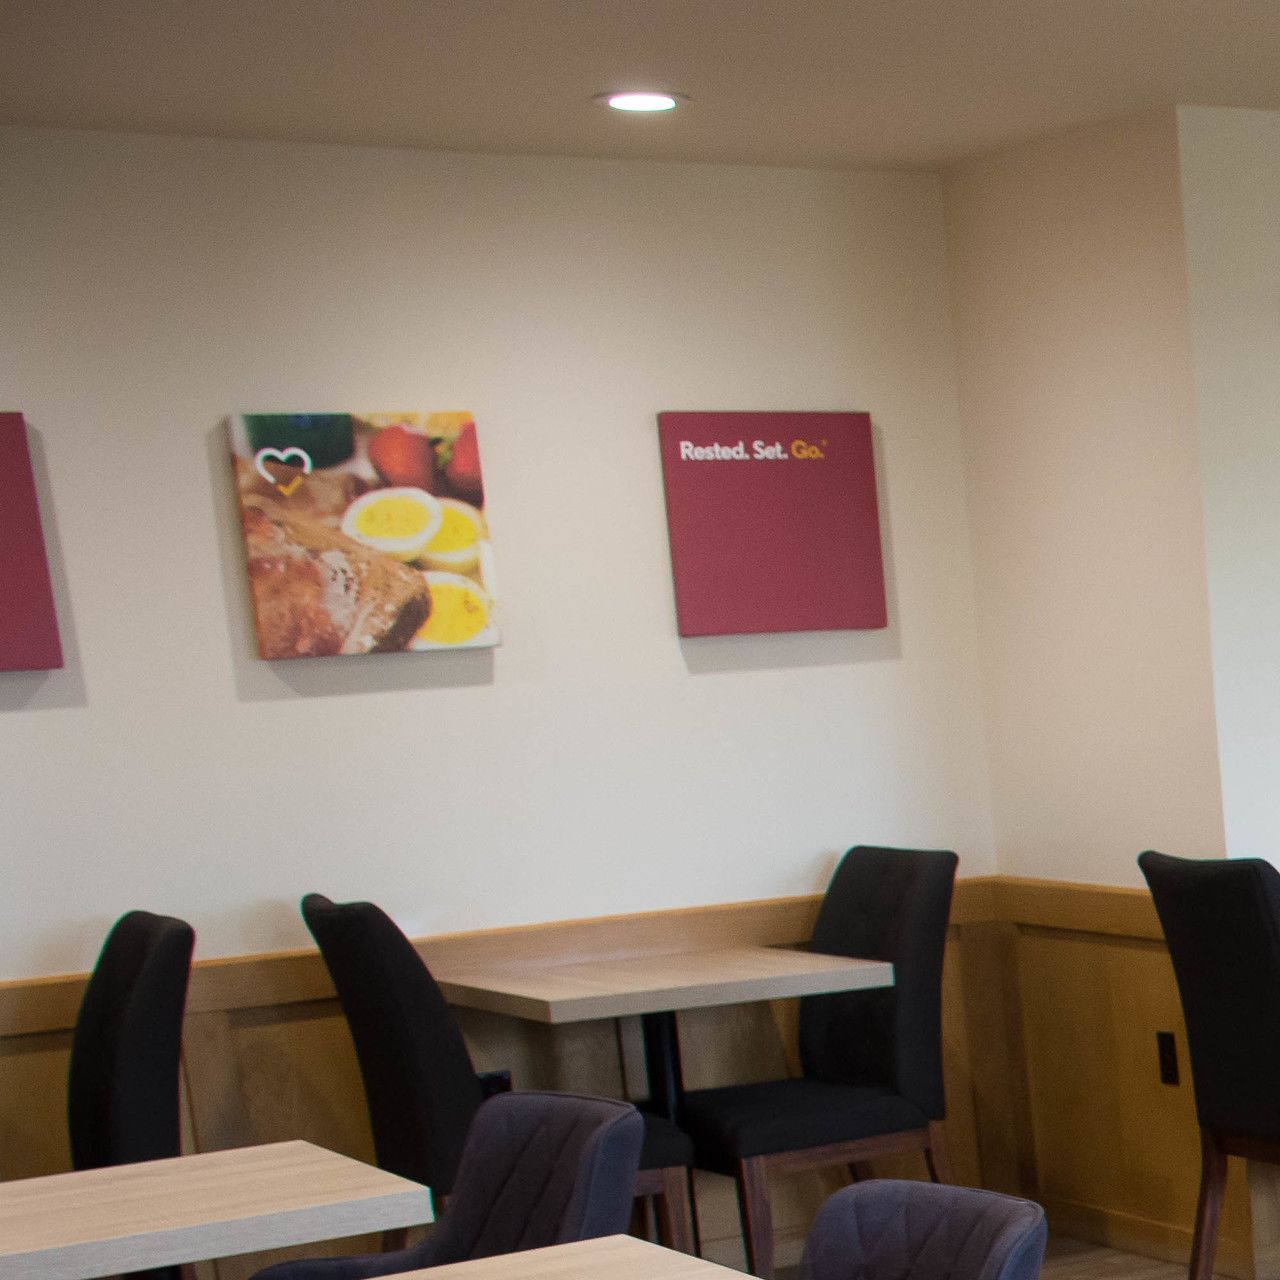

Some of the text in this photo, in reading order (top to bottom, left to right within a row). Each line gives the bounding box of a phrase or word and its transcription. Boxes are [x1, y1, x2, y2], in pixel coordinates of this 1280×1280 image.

[679, 439, 825, 461] Rested. Set. Go.
